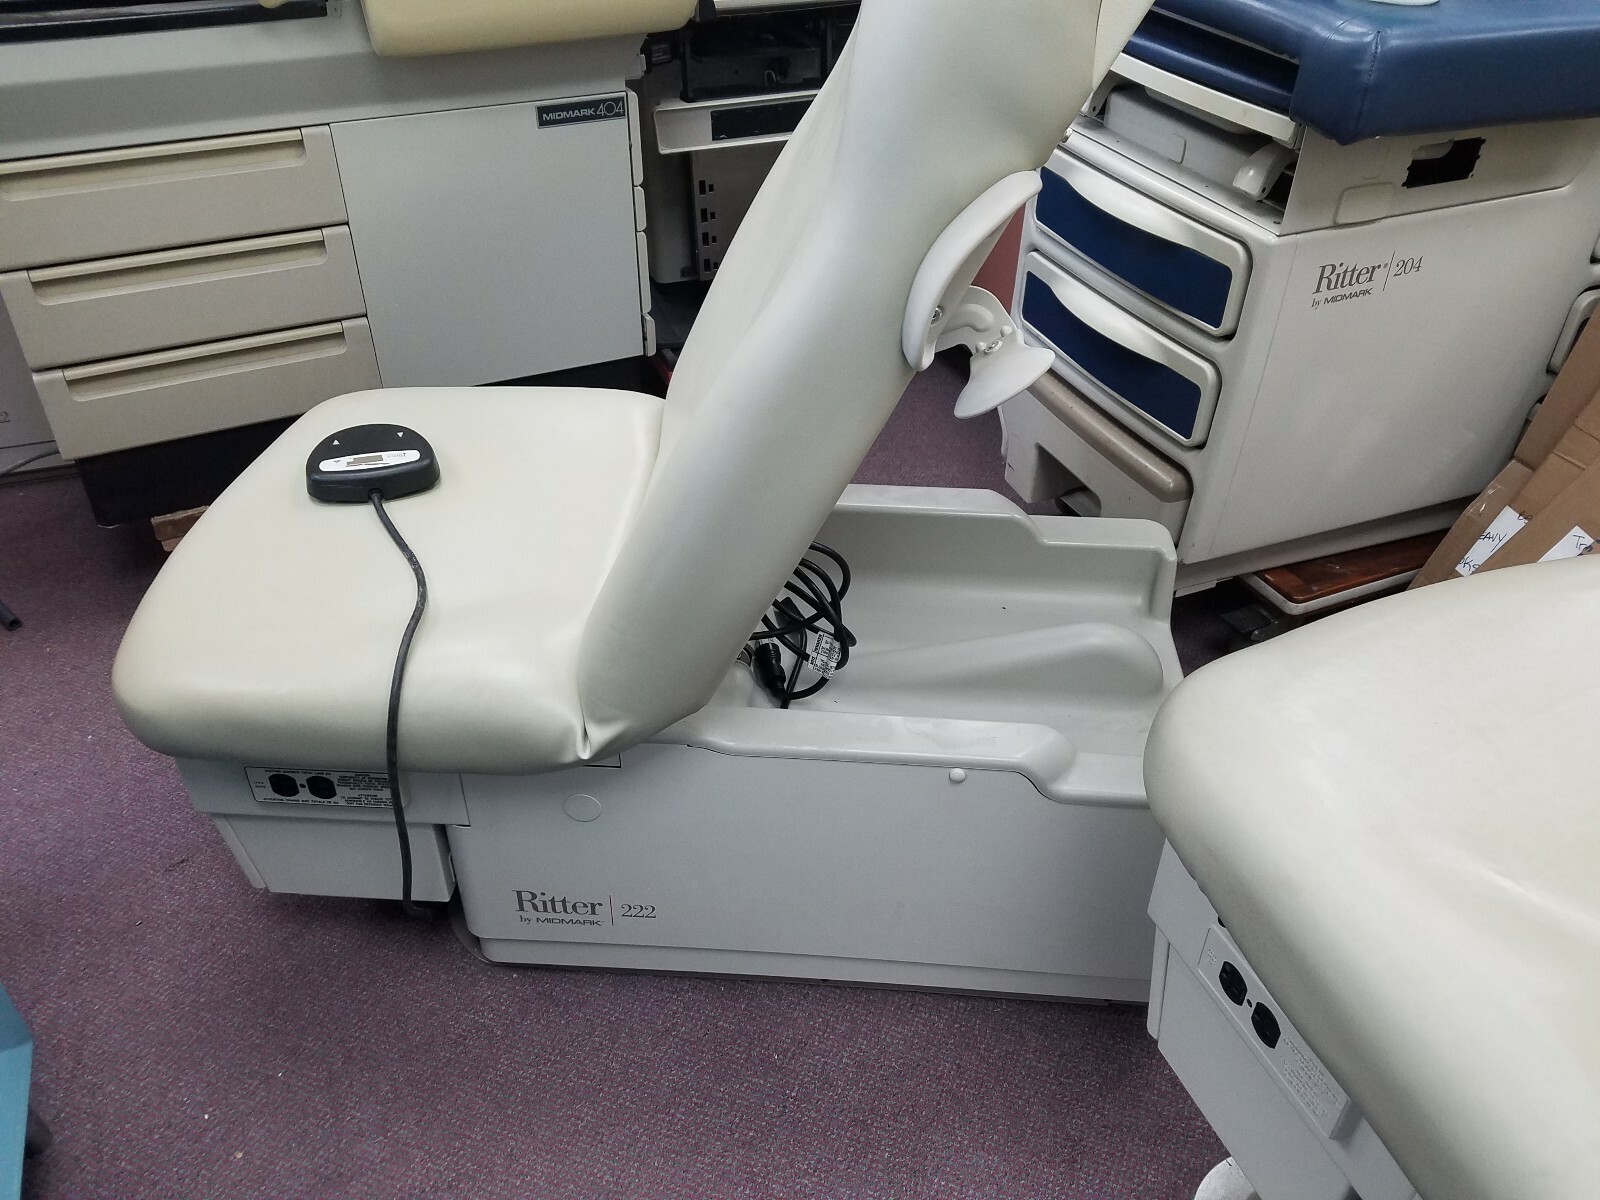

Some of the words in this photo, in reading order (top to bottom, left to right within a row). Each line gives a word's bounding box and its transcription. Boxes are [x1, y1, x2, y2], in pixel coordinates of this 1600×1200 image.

[543, 108, 596, 121] MIDMARK
[596, 100, 624, 117] 404
[1312, 261, 1382, 295] Ritter
[1393, 255, 1424, 278] 204
[1311, 298, 1322, 311] by
[1323, 287, 1374, 305] MIDMARK
[511, 889, 604, 916] Ritter
[620, 903, 658, 919] 222
[518, 914, 532, 925] by
[536, 917, 603, 927] MIDMARK
